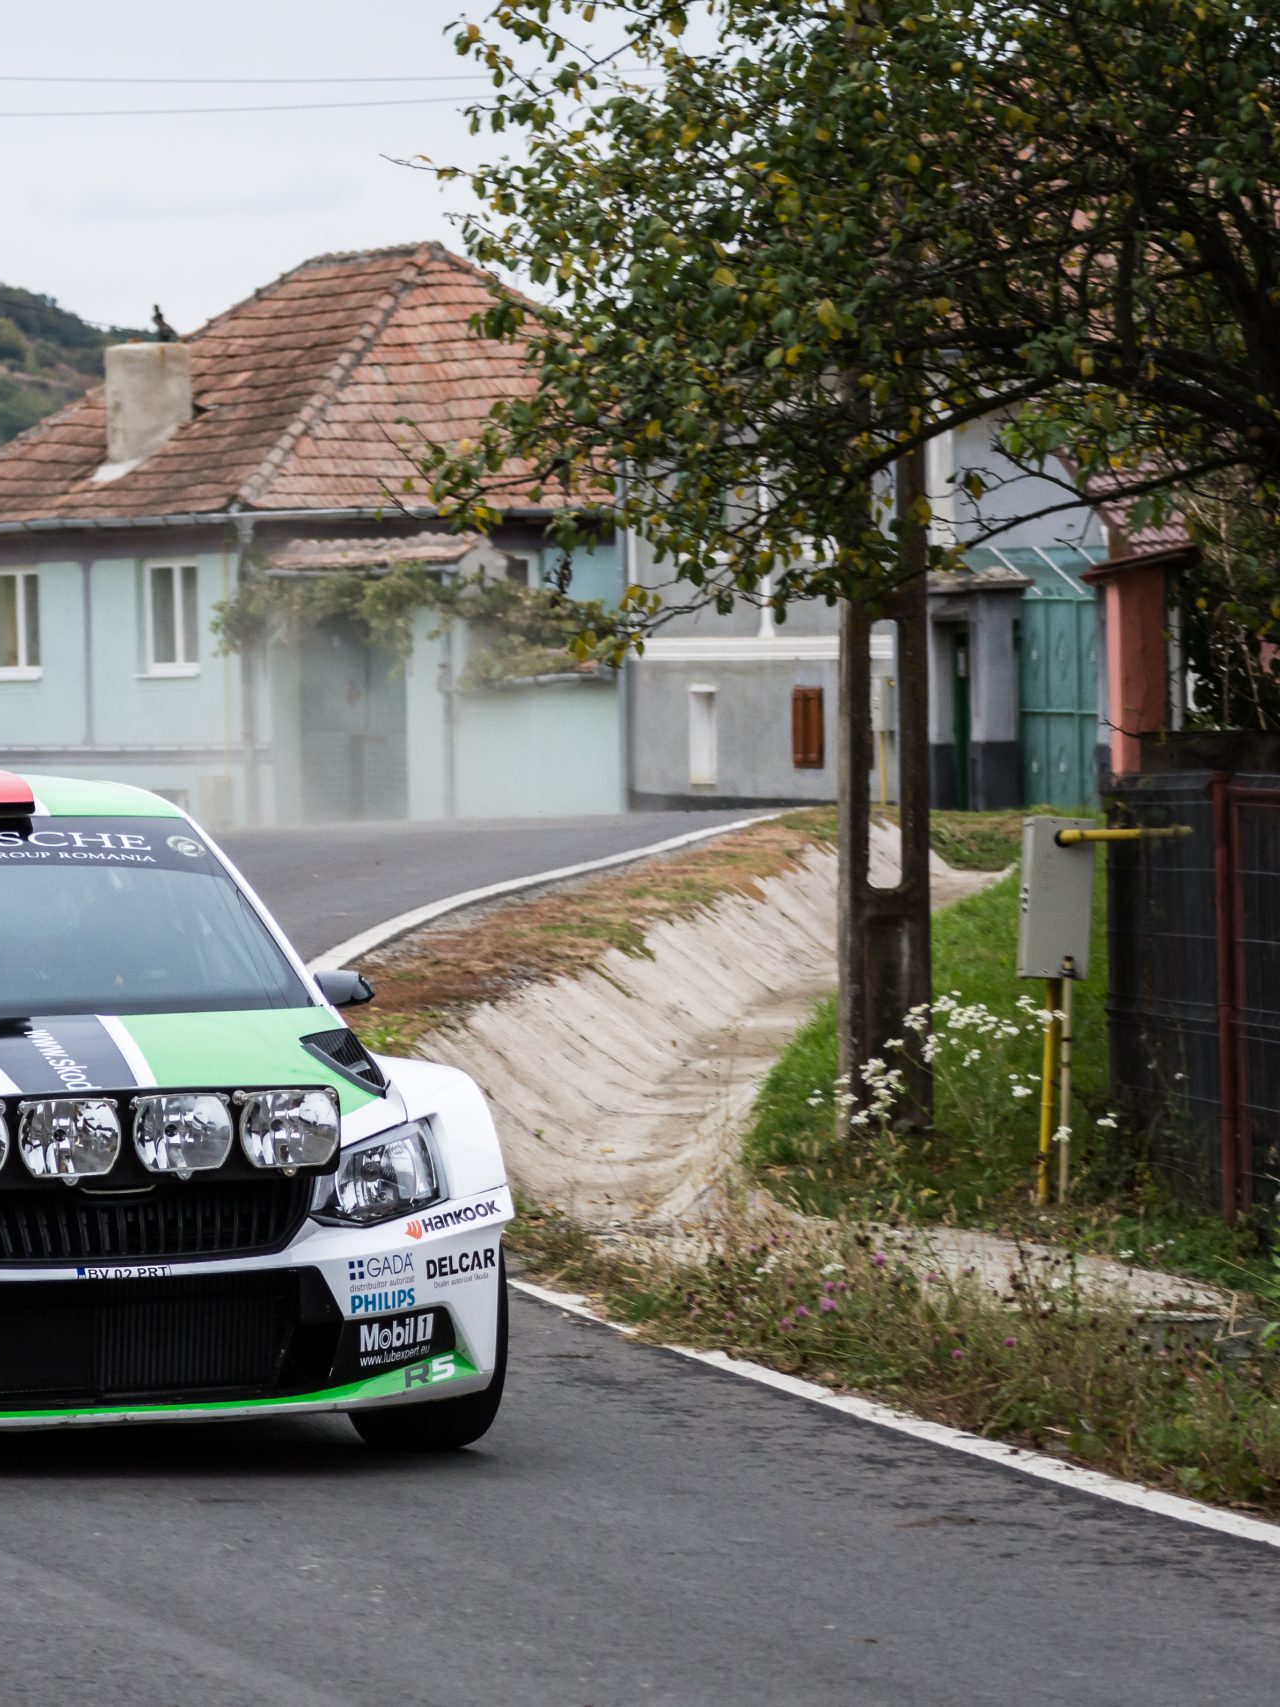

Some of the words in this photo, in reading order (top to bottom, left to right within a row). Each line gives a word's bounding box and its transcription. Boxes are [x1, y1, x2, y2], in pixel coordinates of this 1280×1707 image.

[58, 852, 157, 863] ROMANIA
[88, 1269, 109, 1279] BV
[137, 1266, 168, 1277] PRT
[425, 1248, 496, 1280] DELCAR
[349, 1280, 388, 1293] distribuitor
[350, 1287, 416, 1315] PHILIPS
[359, 1317, 415, 1353] Mobil
[359, 1343, 431, 1368] www.lubexpert.eu
[404, 1354, 456, 1389] R5
